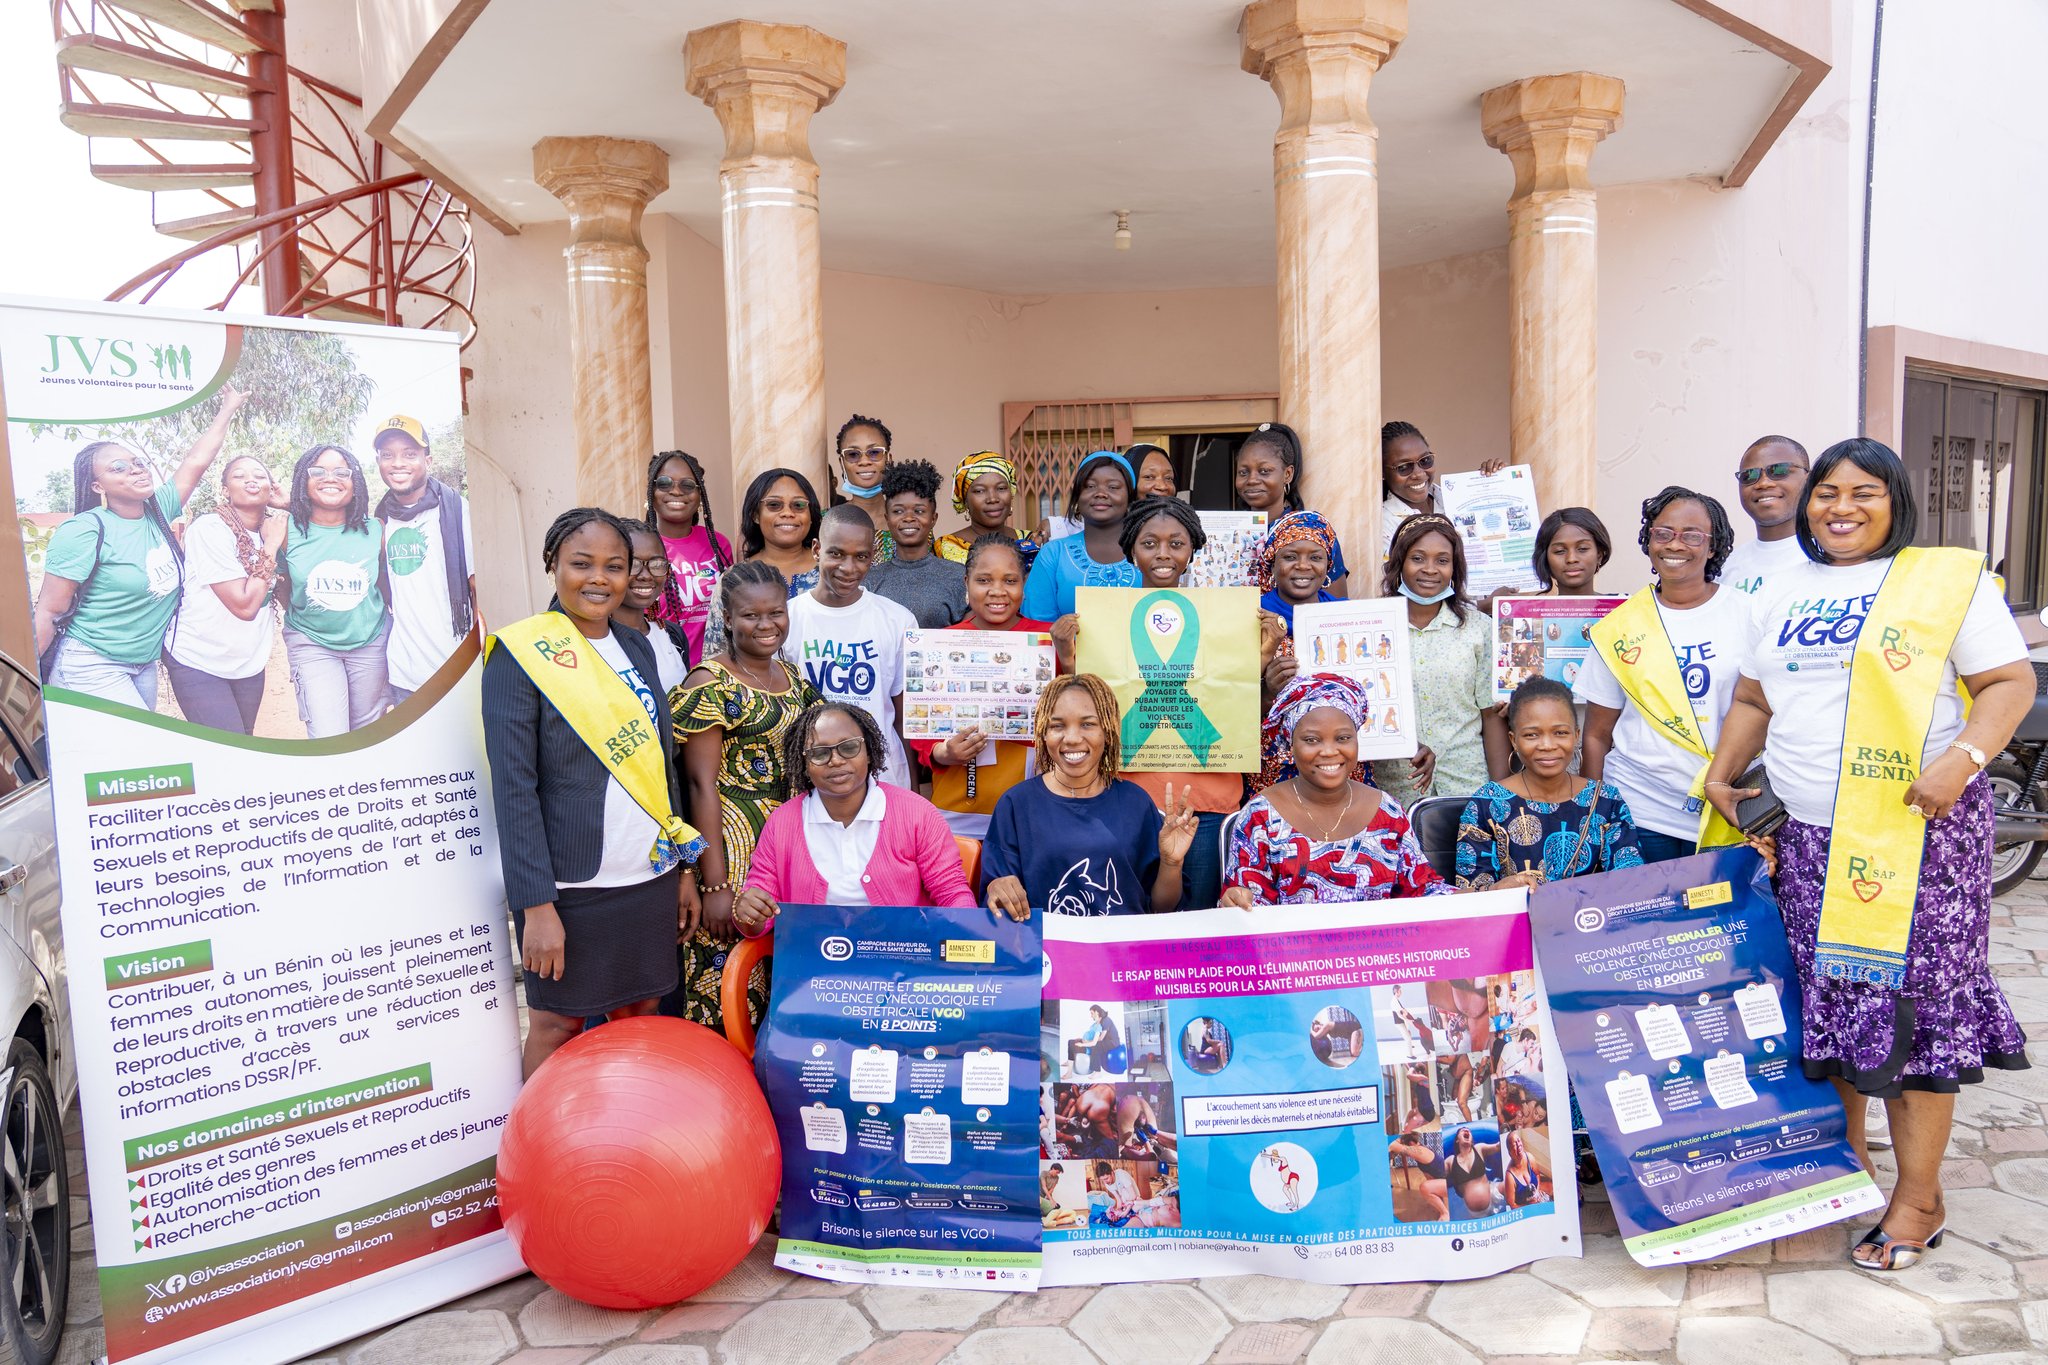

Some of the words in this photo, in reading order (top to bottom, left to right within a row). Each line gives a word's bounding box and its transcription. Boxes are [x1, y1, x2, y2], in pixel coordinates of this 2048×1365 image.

[41, 334, 138, 377] JVS
[39, 376, 76, 384] Jeunes
[77, 378, 133, 388] Volontaires
[134, 382, 156, 390] pour
[158, 382, 167, 390] la
[313, 578, 343, 591] JVS
[1789, 593, 1877, 617] HALTE
[1777, 615, 1867, 647] VGO
[804, 640, 878, 660] HALTE
[805, 661, 875, 695] VGO
[1139, 704, 1179, 712] ÉRADIQUER
[1139, 721, 1193, 729] OBSTÉTRICALES
[98, 774, 182, 796] Mission
[88, 808, 164, 828] Faciliter
[167, 798, 231, 819] l'accès
[233, 795, 267, 810] des
[269, 788, 326, 810] jeunes
[328, 784, 345, 798] et
[347, 781, 378, 796] des
[379, 774, 447, 791] femmes
[449, 769, 475, 784] aux
[99, 902, 260, 938] Communication.
[948, 944, 976, 952] AMNESTY
[1575, 940, 1650, 964] RECONNAITRE
[1653, 937, 1665, 947] ET
[1666, 926, 1723, 945] SIGNALER
[1723, 920, 1748, 932] UNE
[1111, 970, 1123, 982] LE
[1125, 969, 1152, 981] RSAP
[1153, 967, 1186, 980] BENIN
[1187, 965, 1224, 979] PLAIDE
[1225, 964, 1257, 977] POUR
[1258, 958, 1333, 975] L'ÉLIMINATION
[1334, 956, 1355, 969] DES
[1357, 953, 1401, 966] NORMES
[1402, 947, 1470, 963] HISTORIQUES
[1584, 956, 1638, 975] VIOLENCE
[1638, 937, 1734, 964] GYNÉCOLOGIQUE
[1735, 933, 1748, 943] ET
[116, 955, 185, 978] Vision
[1614, 958, 1692, 981] OBSTÉTRICALE
[1694, 951, 1726, 967] (VGO)
[811, 980, 894, 992] RECONNAITRE
[898, 982, 912, 992] ET
[914, 983, 974, 993] SIGNALER
[977, 984, 1002, 993] UNE
[1154, 982, 1207, 995] NUISIBLES
[1208, 980, 1239, 993] POUR
[1240, 980, 1255, 992] LA
[1257, 975, 1293, 991] SANTÉ
[1294, 971, 1359, 988] MATERNELLE
[1361, 970, 1374, 982] ET
[1375, 965, 1436, 981] NÉONATALE
[1637, 979, 1652, 990] EN
[1654, 976, 1662, 987] 8
[1664, 968, 1704, 984] POINTS
[814, 992, 873, 1004] VIOLENCE
[876, 993, 979, 1006] GYNÉCOLOGIQUE
[982, 996, 996, 1006] ET
[842, 1005, 928, 1017] OBSTÉTRICALE
[931, 1008, 965, 1020] (VGO)
[863, 1019, 878, 1029] EN
[881, 1020, 888, 1030] 8
[891, 1020, 937, 1031] POINTS
[137, 1139, 179, 1161] Nos
[182, 1110, 285, 1148] domaines
[288, 1075, 420, 1119] d'intervention
[150, 1175, 214, 1208] Egalité
[217, 1168, 251, 1187] des
[254, 1150, 316, 1180] genres
[1663, 1196, 1704, 1216] Brisons
[1705, 1193, 1716, 1206] le
[1716, 1182, 1754, 1201] silence
[1755, 1176, 1772, 1189] sur
[1775, 1168, 1790, 1184] les
[1790, 1162, 1815, 1179] VGO
[154, 1187, 320, 1248] Recherche-action
[448, 1206, 463, 1220] 52
[466, 1202, 481, 1214] 52
[822, 1222, 860, 1238] Brisons
[862, 1228, 872, 1239] le
[875, 1227, 917, 1238] silence
[919, 1229, 938, 1238] sur
[941, 1227, 957, 1239] les
[961, 1229, 989, 1239] VGO
[1468, 1238, 1490, 1249] Rsap
[1490, 1232, 1509, 1245] Benin
[1072, 1242, 1172, 1258] rsapbenin@gmail.com
[1178, 1241, 1260, 1253] nobiane@yahoo.fr
[1335, 1246, 1347, 1258] 64
[1350, 1245, 1362, 1255] 08
[1365, 1244, 1378, 1254] 83
[1381, 1242, 1394, 1252] 83
[163, 1232, 393, 1315] www.associationjvs@gmail.com
[188, 1239, 305, 1286] @jvsassociation
